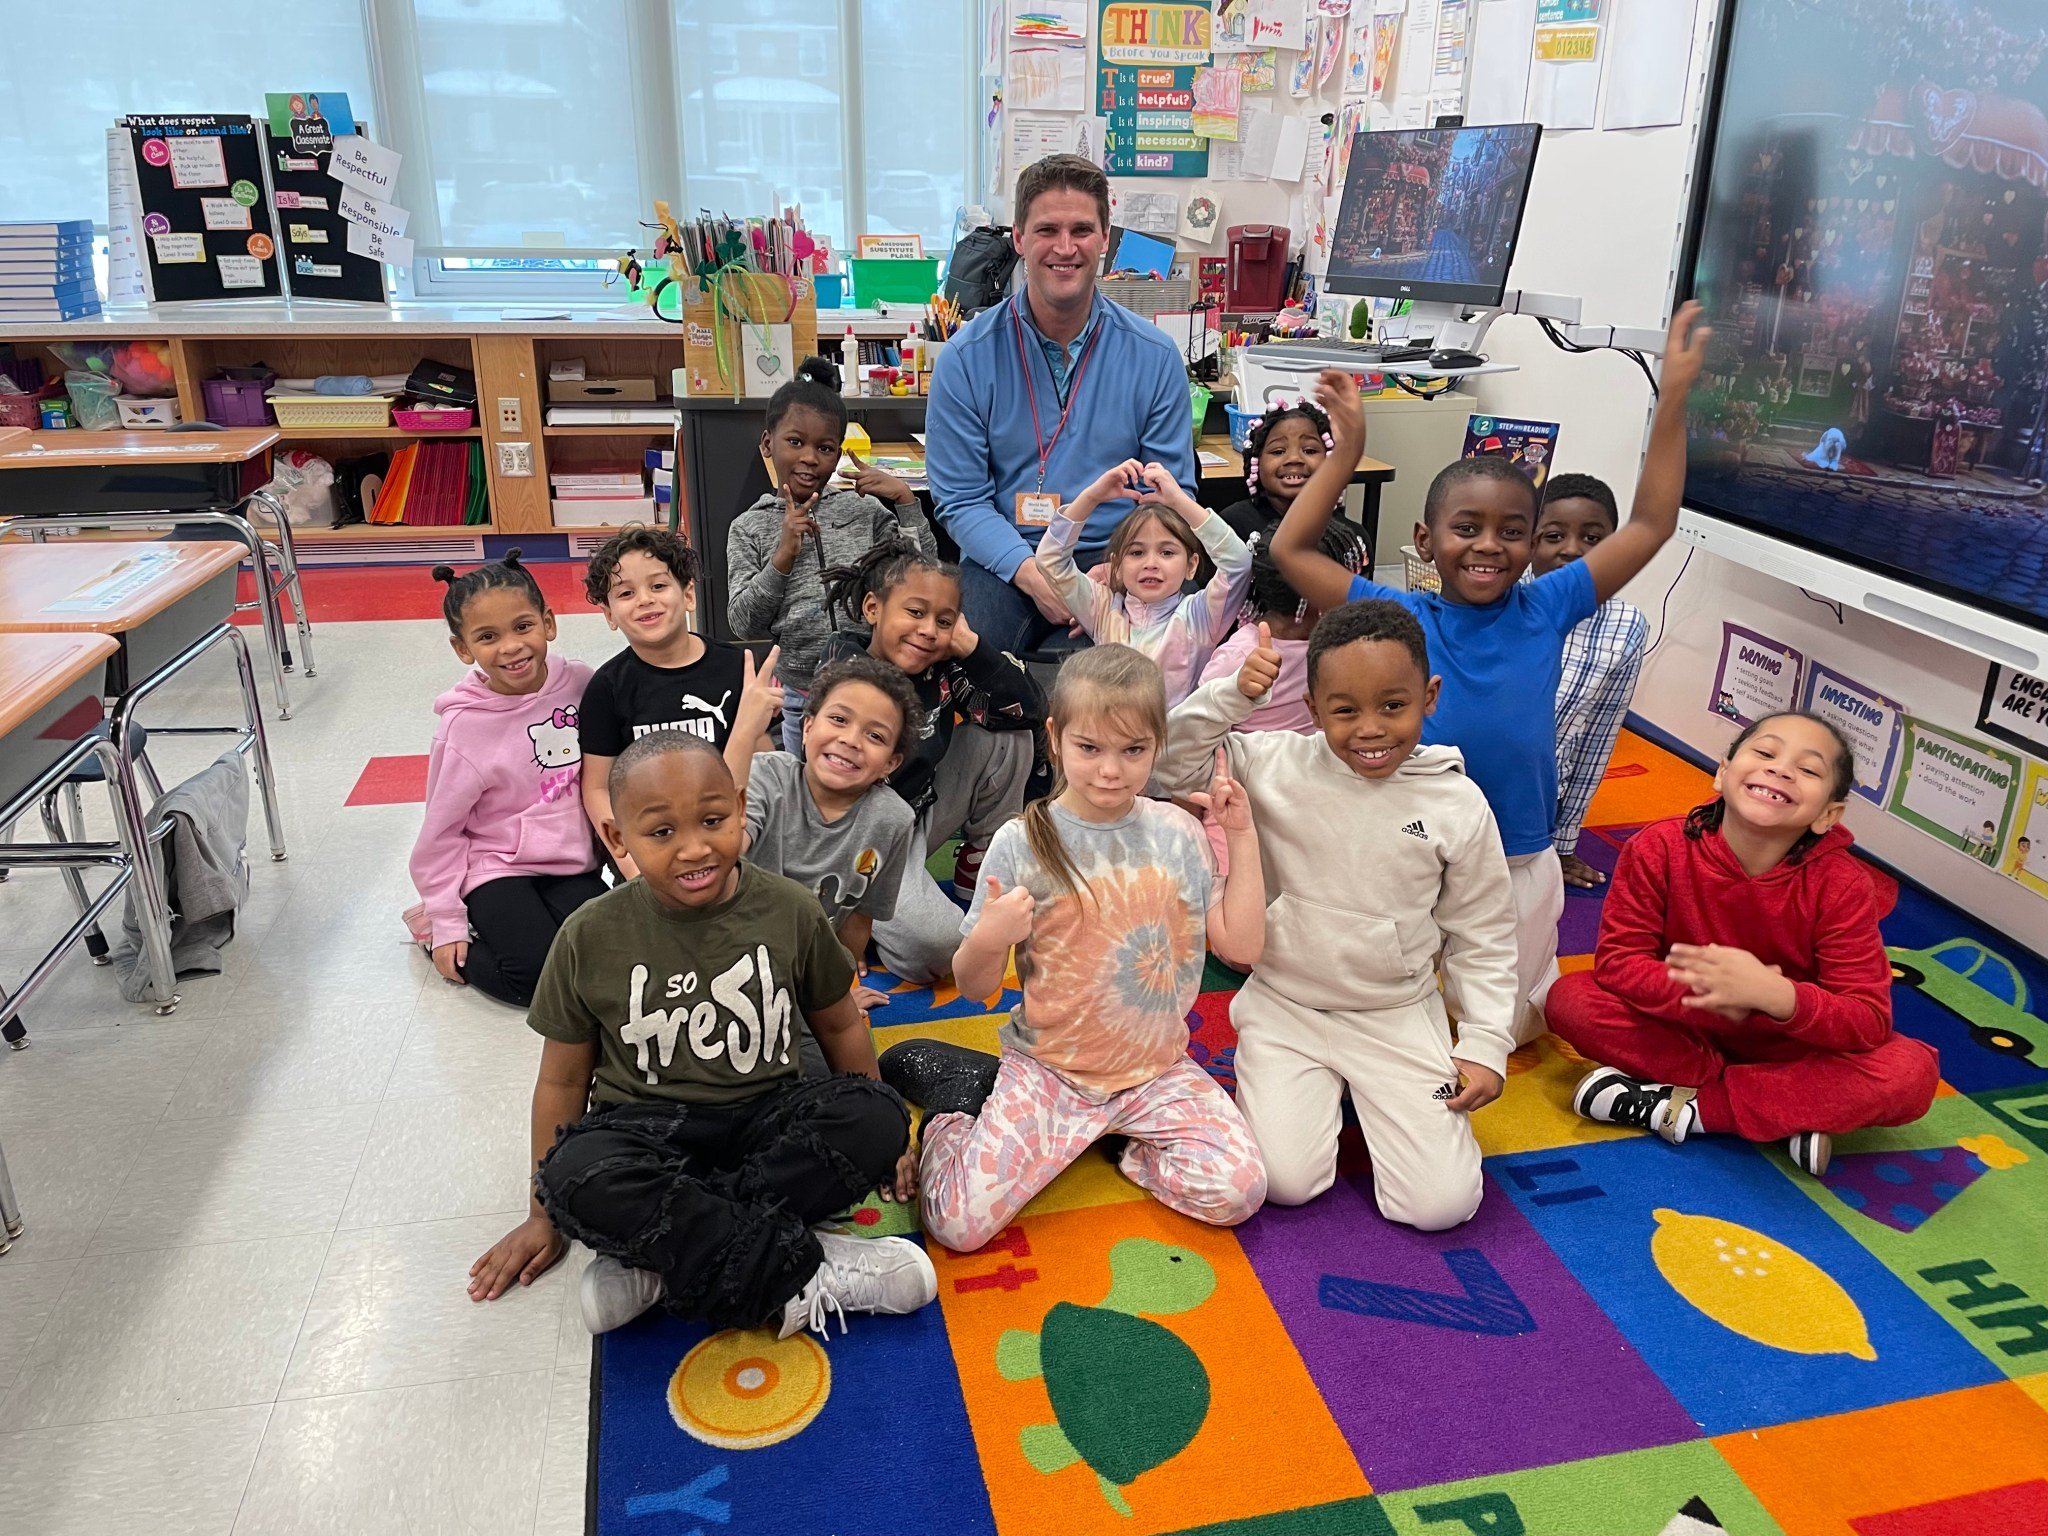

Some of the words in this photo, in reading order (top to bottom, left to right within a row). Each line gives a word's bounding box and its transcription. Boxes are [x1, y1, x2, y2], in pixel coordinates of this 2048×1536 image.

[1108, 8, 1205, 46] THINK
[1109, 47, 1146, 58] Before
[1174, 50, 1206, 61] Speak
[1101, 68, 1118, 88] T
[1120, 72, 1126, 82] Is
[1128, 72, 1135, 82] it
[1140, 73, 1172, 84] true?
[1102, 89, 1116, 110] H
[1119, 96, 1125, 105] Is
[1128, 96, 1134, 105] it
[1138, 93, 1190, 108] helpful?
[127, 116, 156, 126] What
[158, 116, 179, 125] does
[181, 116, 216, 127] respect
[1118, 117, 1125, 126] Is
[1128, 117, 1134, 126] it
[142, 127, 162, 136] look
[166, 126, 184, 135] like
[200, 125, 227, 135] sound
[298, 125, 305, 134] A
[305, 125, 324, 134] Great
[295, 135, 331, 145] Classmate
[1118, 136, 1124, 145] Is
[1127, 136, 1133, 145] it
[1138, 136, 1203, 148] necessary?
[355, 150, 368, 163] Be
[1118, 157, 1123, 167] Is
[1126, 157, 1132, 167] it
[1137, 156, 1168, 167] kind?
[335, 154, 388, 186] Respectful
[277, 196, 287, 204] Is
[364, 201, 377, 215] Be
[341, 201, 400, 236] Responsible
[292, 229, 307, 240] Says
[371, 234, 382, 245] Be
[368, 245, 385, 259] Safe
[1480, 421, 1489, 431] 2
[1499, 422, 1513, 430] STEP
[1523, 426, 1550, 435] READING
[1739, 646, 1782, 676] DRIVING
[1759, 677, 1774, 687] goals
[1738, 678, 1758, 692] seeking
[1759, 686, 1783, 703] feedback
[1746, 694, 1777, 710] assessment
[1820, 684, 1883, 726] INVESTING
[2002, 694, 2036, 717] ARE
[1826, 711, 1847, 728] asking
[1848, 722, 1878, 742] questions
[1916, 737, 2009, 789] PARTICIPATING
[1926, 763, 1950, 780] paying
[1951, 776, 1985, 796] attention
[1923, 774, 1943, 791] doing
[1945, 786, 1957, 797] the
[1958, 793, 1976, 806] work
[1402, 827, 1428, 840] adidas
